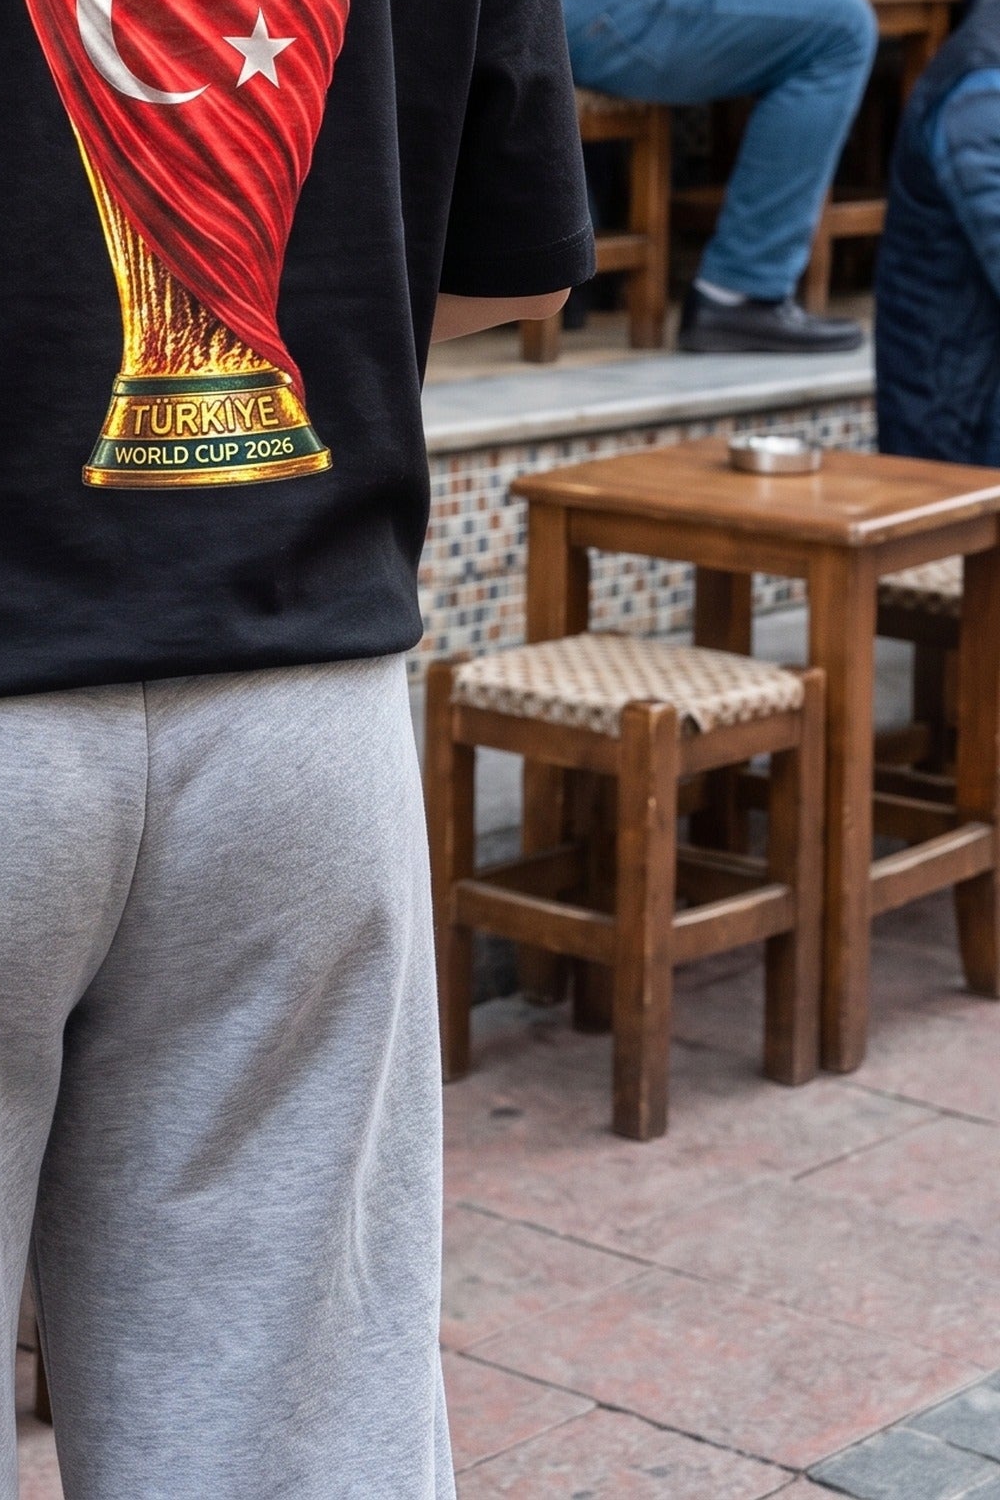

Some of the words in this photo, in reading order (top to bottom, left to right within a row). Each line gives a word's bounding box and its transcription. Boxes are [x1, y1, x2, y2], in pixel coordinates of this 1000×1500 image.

[115, 446, 189, 465] WORLD
[195, 443, 239, 463] CUP
[244, 437, 294, 459] 2026
